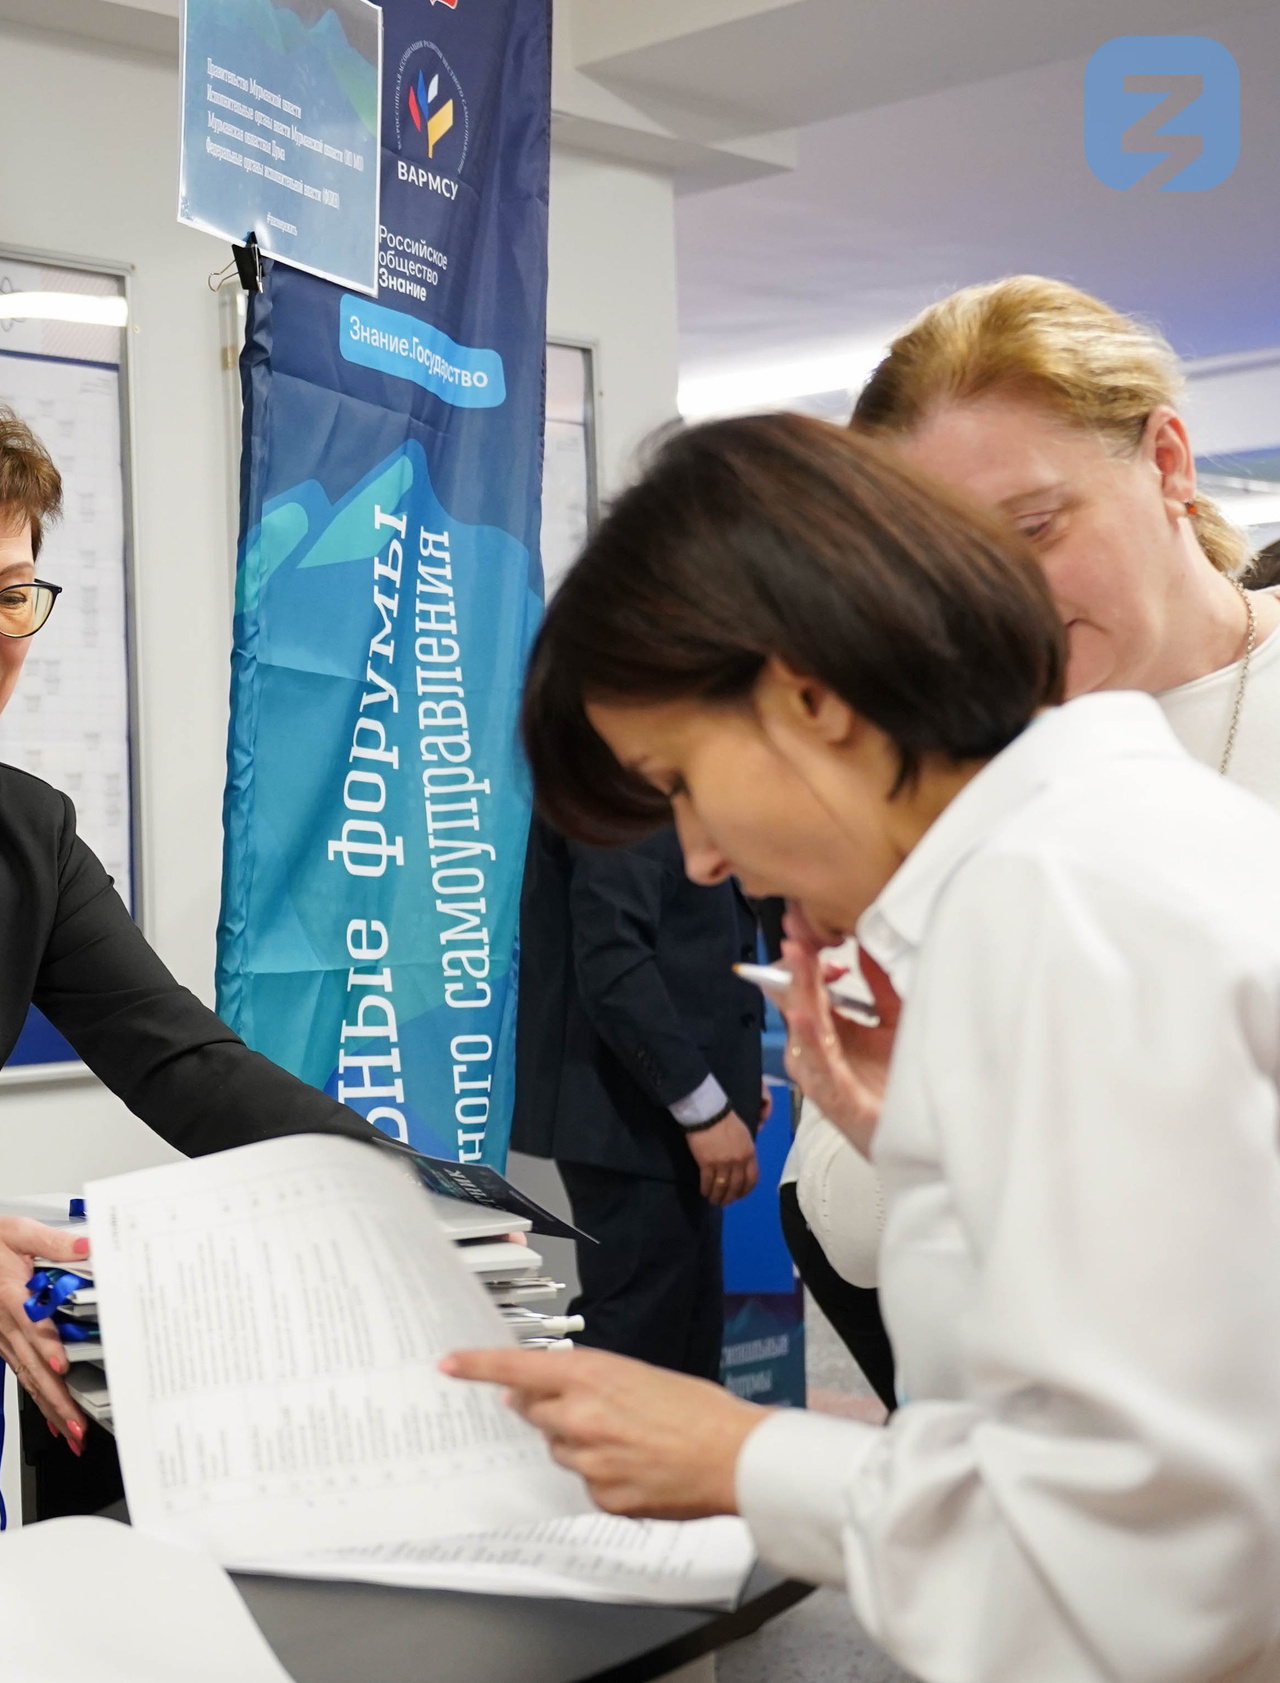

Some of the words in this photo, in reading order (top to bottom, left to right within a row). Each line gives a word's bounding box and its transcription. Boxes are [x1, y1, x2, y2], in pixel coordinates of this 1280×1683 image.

[397, 160, 459, 201] ВАРМСУ
[379, 224, 448, 270] Российское
[379, 250, 439, 286] общество
[379, 267, 427, 302] Знание
[328, 503, 409, 878] форумы
[414, 525, 497, 1010] самоуправления
